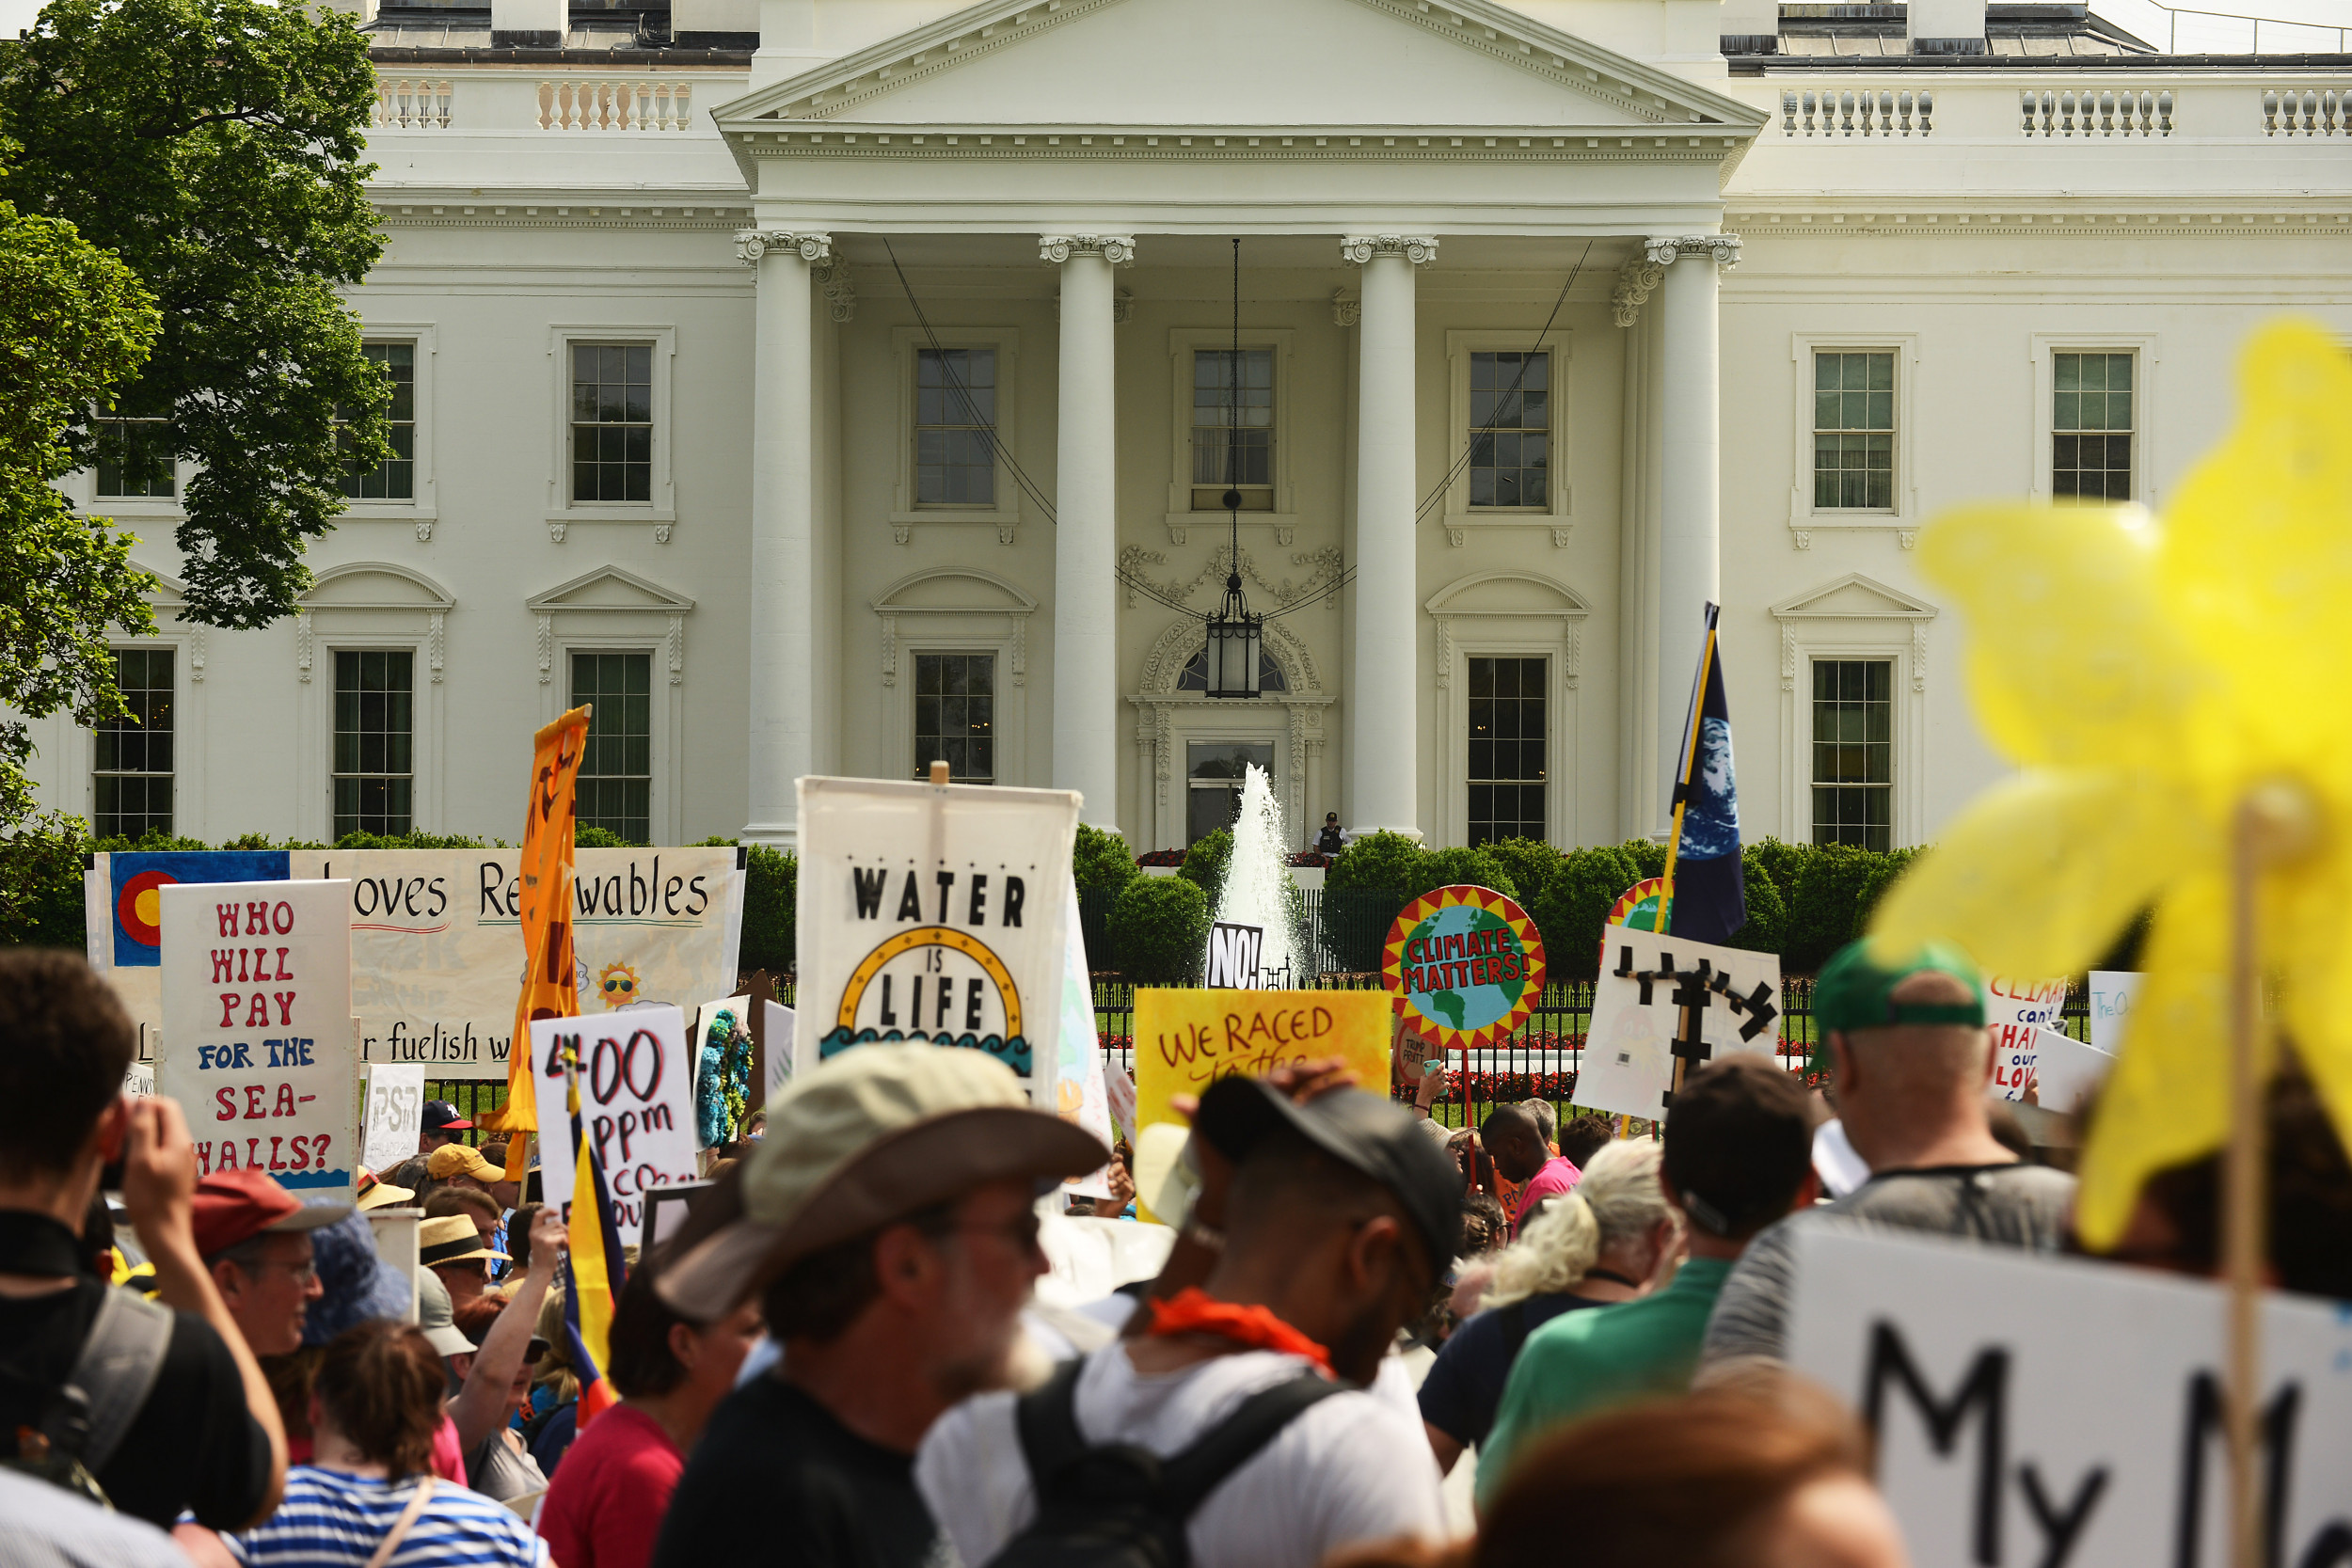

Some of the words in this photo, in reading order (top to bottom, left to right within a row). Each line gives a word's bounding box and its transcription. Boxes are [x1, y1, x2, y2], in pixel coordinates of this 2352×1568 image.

[480, 855, 709, 917] Rewables
[852, 865, 1025, 928] WATER
[215, 900, 294, 938] WHO
[210, 947, 294, 984] WILL
[927, 948, 944, 974] IS
[1210, 926, 1262, 990] NO!
[1406, 927, 1513, 964] CLIMATE
[1402, 952, 1531, 995] MATTERS!
[218, 990, 296, 1028] PAY
[880, 974, 984, 1031] LIFE
[197, 1042, 255, 1070] FOR
[262, 1037, 315, 1069] THE
[387, 1021, 478, 1061] fuelish
[1159, 1022, 1217, 1069] WE
[1224, 1006, 1333, 1053] RACED
[545, 1028, 664, 1106] 400
[215, 1082, 317, 1121] SEA-
[192, 1133, 331, 1176] WALLS?
[1863, 1308, 2112, 1568] My
